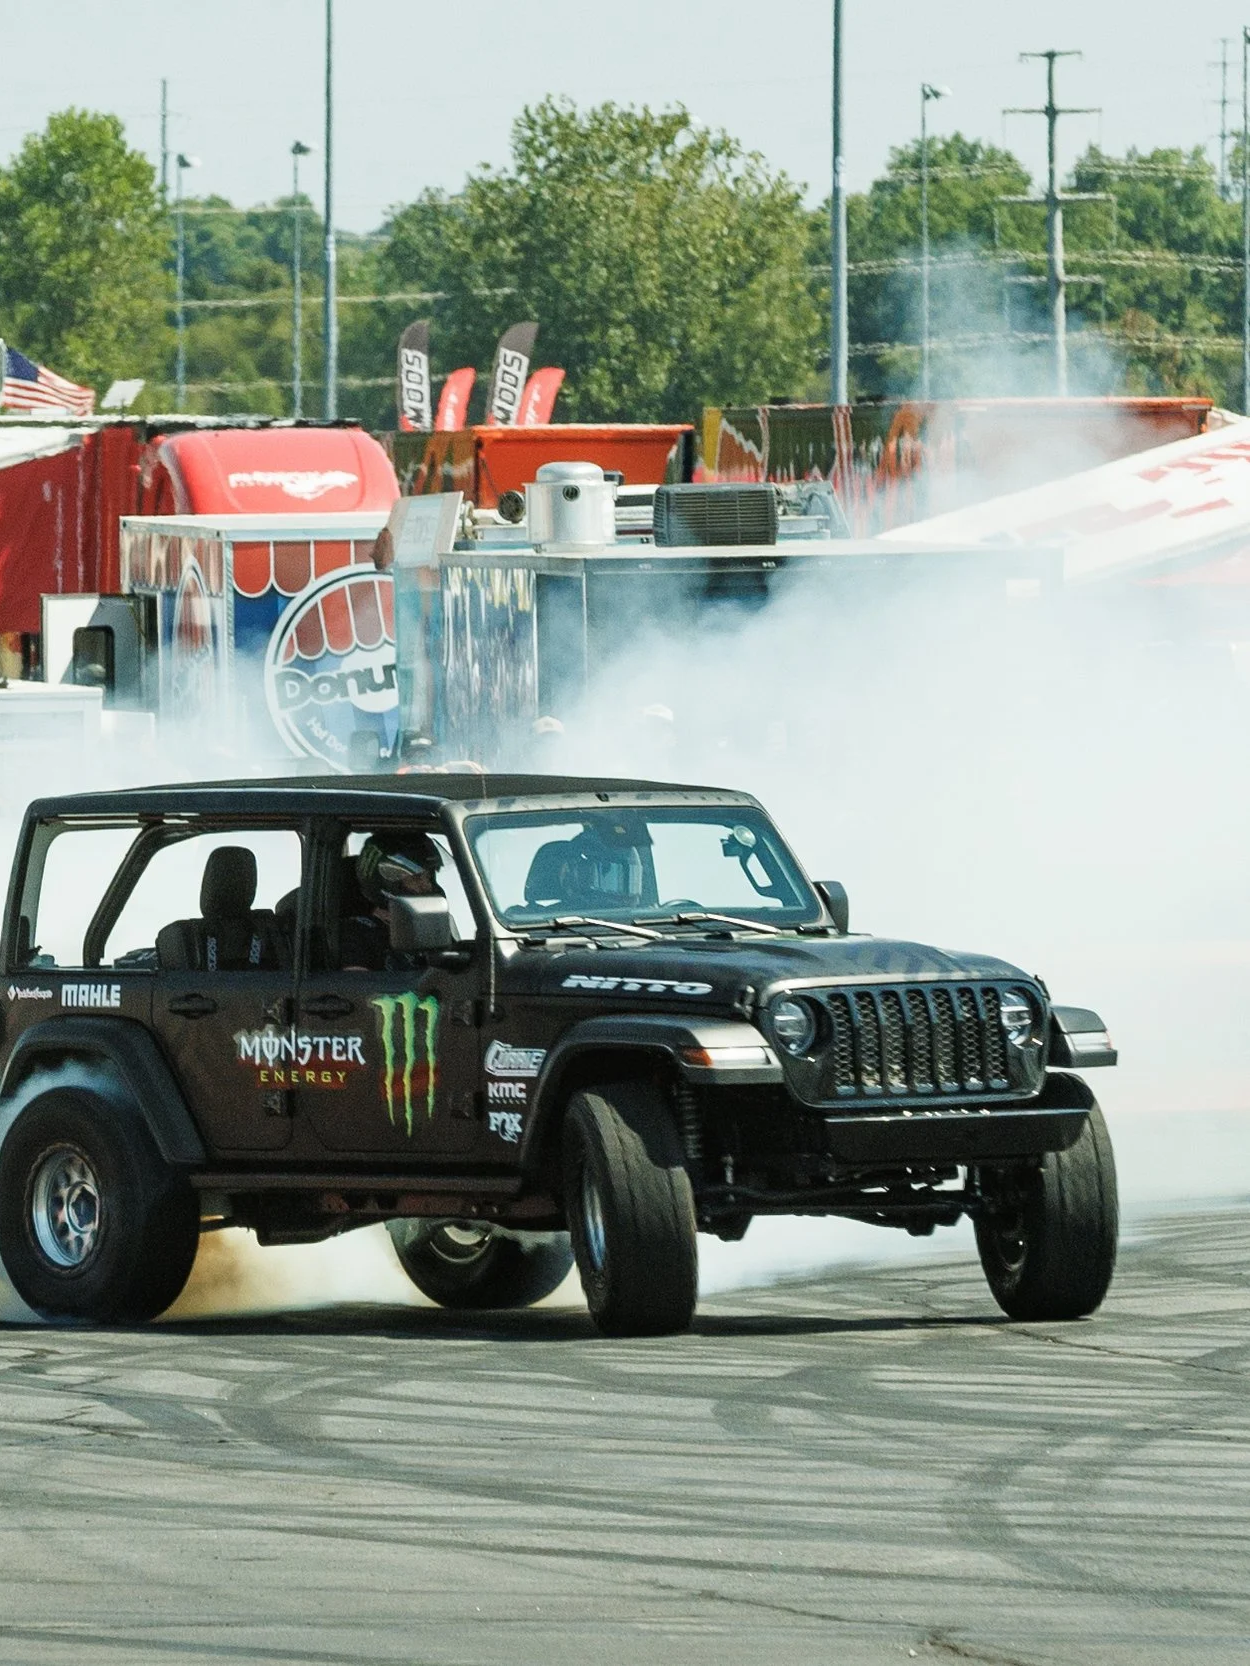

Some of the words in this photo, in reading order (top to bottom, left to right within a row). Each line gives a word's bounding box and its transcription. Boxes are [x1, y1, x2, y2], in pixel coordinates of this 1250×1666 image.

[275, 663, 397, 709] Donu
[61, 984, 121, 1007] MAHLE
[561, 974, 713, 995] NITTO
[239, 1023, 366, 1067] MONSTER
[259, 1070, 347, 1082] ENERGY
[487, 1082, 526, 1098] KMC
[488, 1111, 523, 1142] FOX
